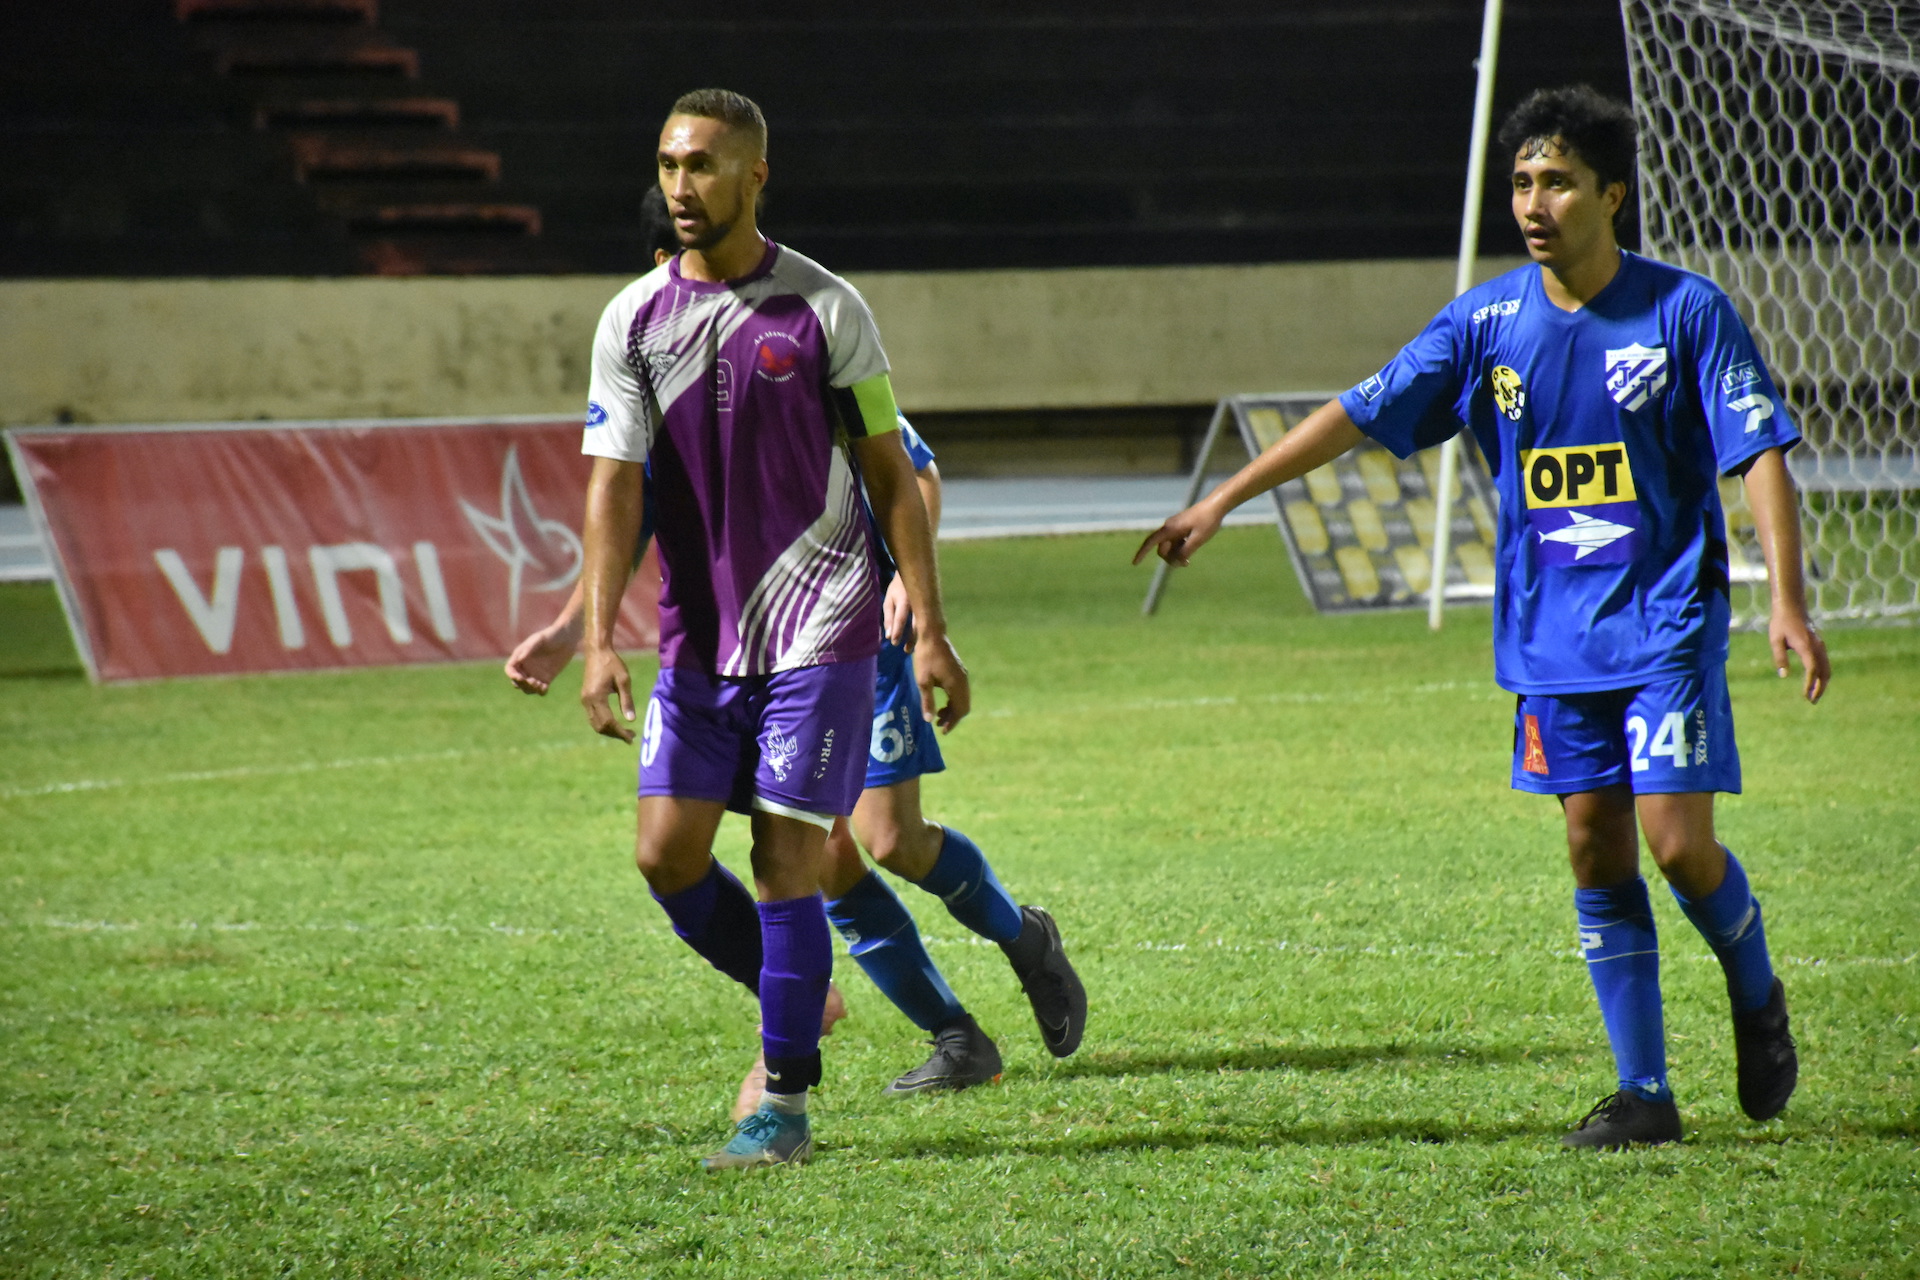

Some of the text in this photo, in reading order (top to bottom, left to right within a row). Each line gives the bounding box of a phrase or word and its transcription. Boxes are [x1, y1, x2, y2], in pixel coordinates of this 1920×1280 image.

[1724, 365, 1754, 387] TMS
[1530, 449, 1623, 502] OPT
[155, 541, 456, 654] VINI
[641, 697, 663, 768] 9
[870, 710, 904, 763] 6
[1627, 711, 1693, 772] 24
